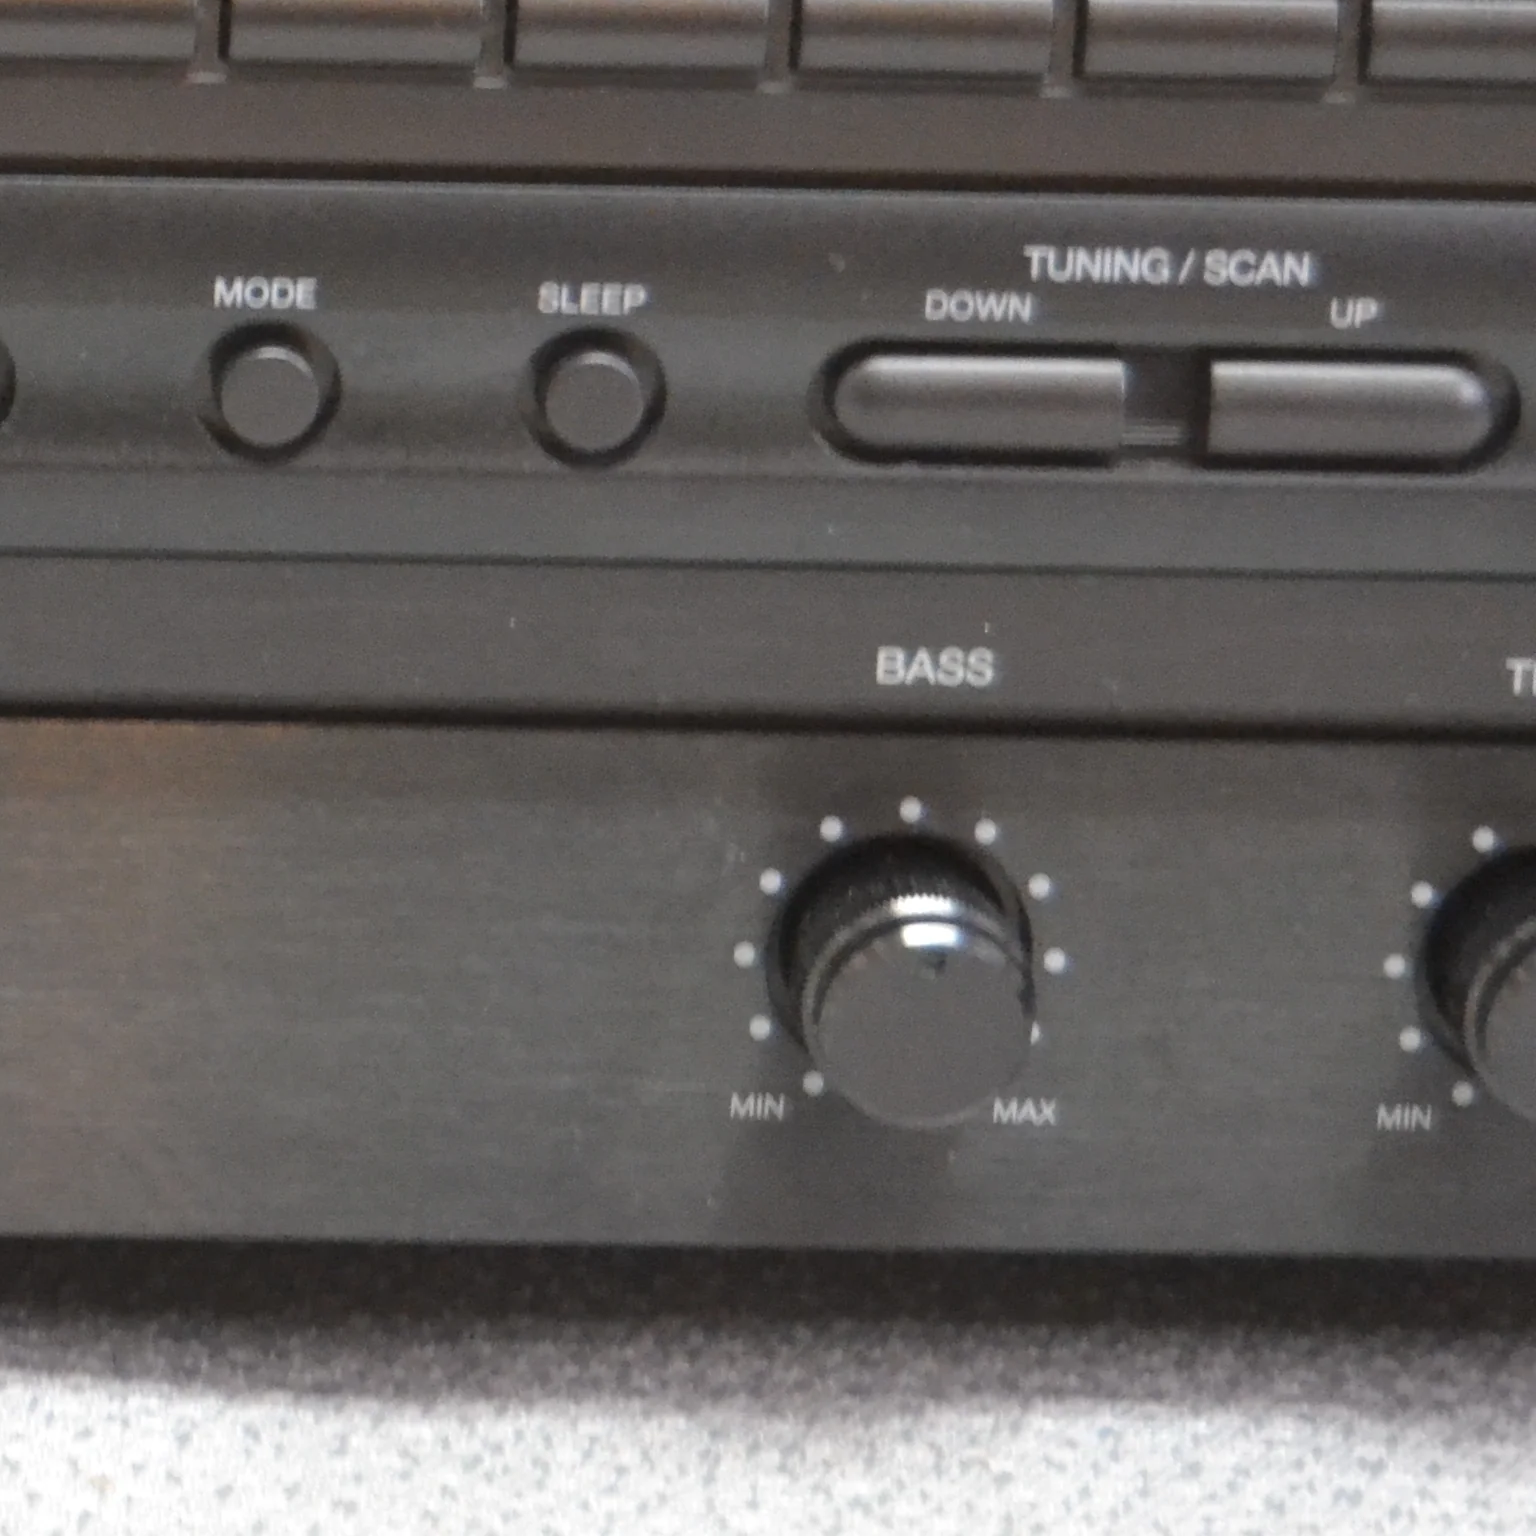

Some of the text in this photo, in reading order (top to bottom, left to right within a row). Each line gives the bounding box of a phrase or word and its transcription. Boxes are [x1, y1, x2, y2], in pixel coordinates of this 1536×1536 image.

[1023, 244, 1171, 284] TUNING
[1204, 248, 1314, 287] SCAN
[214, 277, 318, 311] MODE
[538, 282, 648, 317] SLEEP
[926, 289, 1034, 325] DOWN
[1330, 296, 1380, 329] UP
[875, 648, 996, 687] BASS
[730, 1094, 786, 1120] MIN
[992, 1098, 1058, 1125] MAX
[1377, 1105, 1432, 1131] MIN
